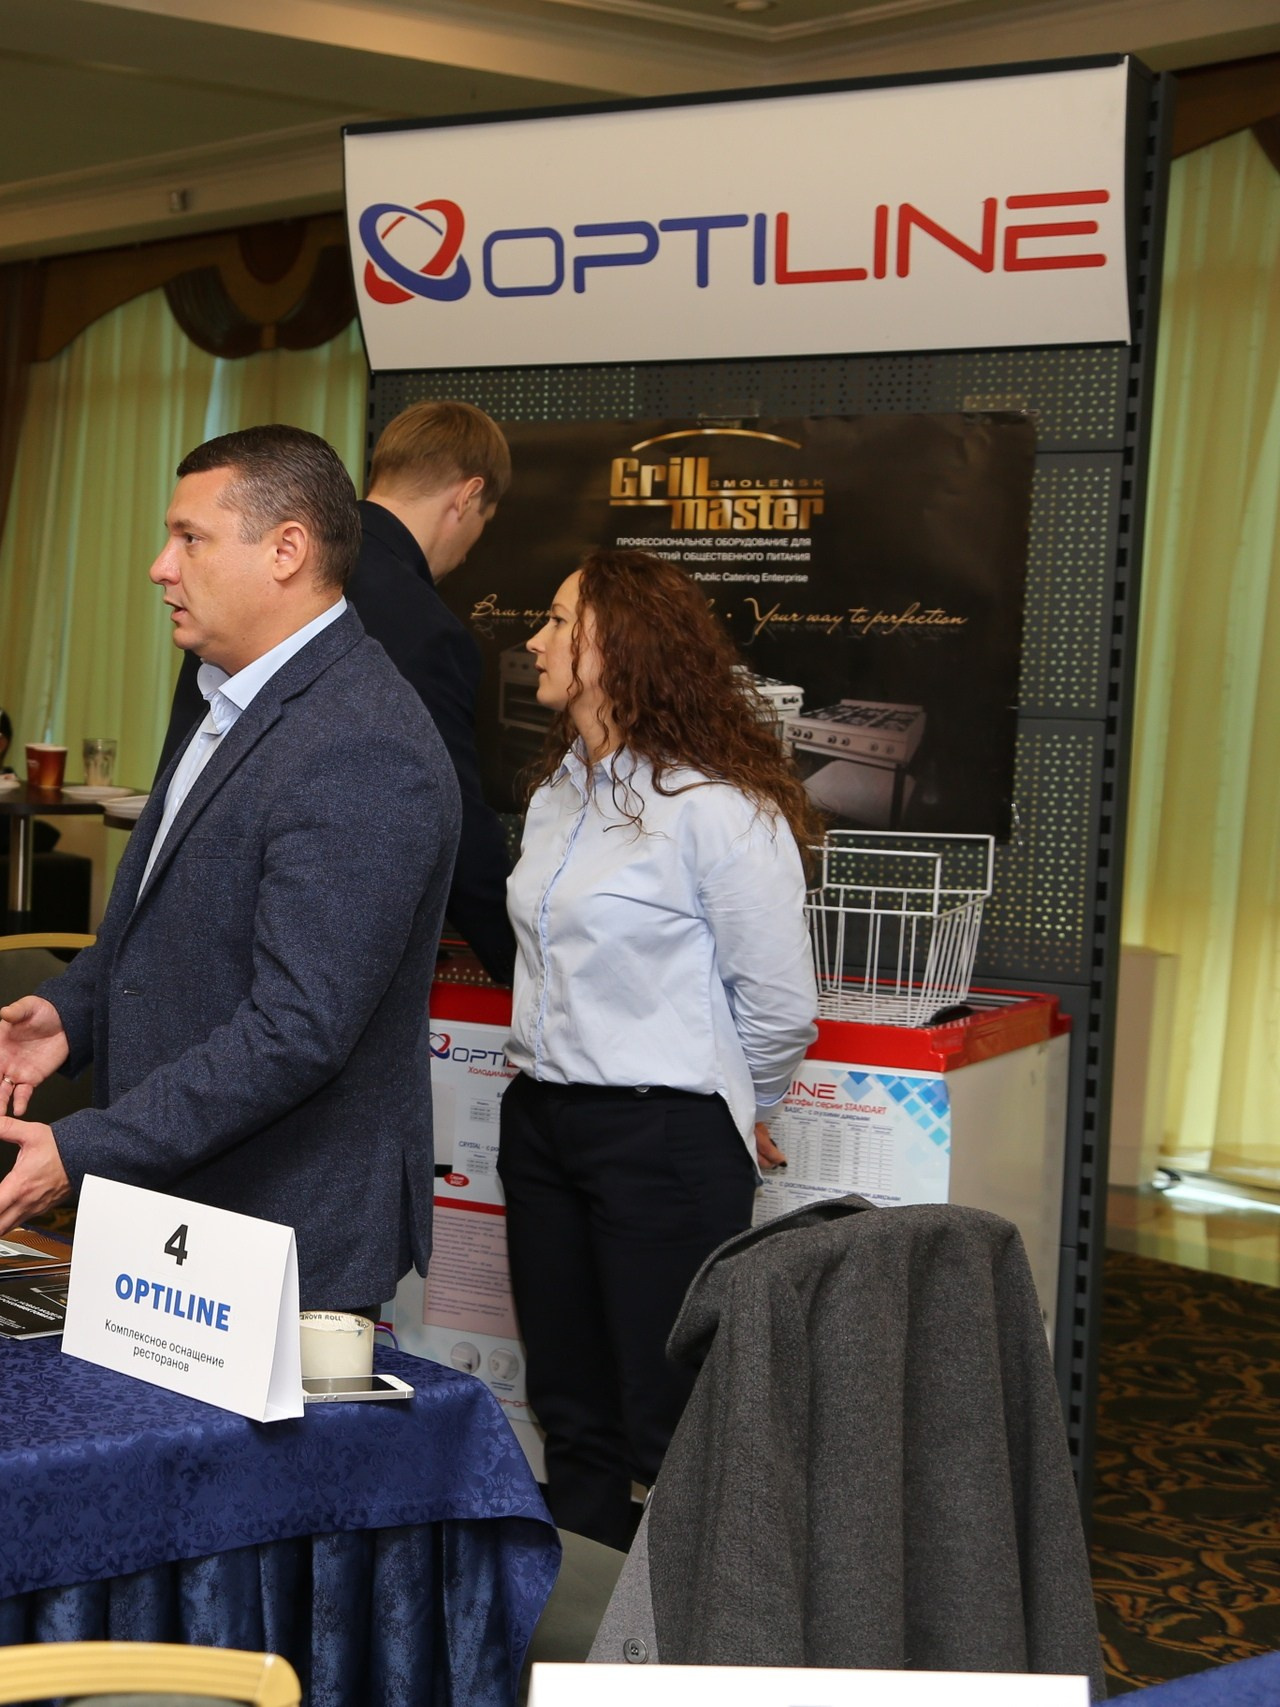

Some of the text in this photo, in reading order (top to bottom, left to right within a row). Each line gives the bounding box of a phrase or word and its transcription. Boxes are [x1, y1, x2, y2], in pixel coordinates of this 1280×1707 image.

[482, 189, 1110, 298] OPTILINE
[610, 457, 710, 497] Grill
[710, 478, 825, 488] SMOLENSK
[671, 495, 825, 531] master
[616, 537, 812, 548] ПРОФЕССИОНАЛЬНОЕ ОБОРУДОВАНИЕ ДЛЯ
[682, 551, 764, 562] ОБЩЕСТВЕННОГО
[766, 551, 811, 562] ПИТАНИЯ
[694, 571, 809, 584] Public Catering Enterprise
[744, 597, 804, 636] Your
[806, 613, 844, 635] way
[848, 606, 868, 624] to
[862, 601, 968, 635] perfection
[468, 1065, 517, 1078] Холодильны
[844, 1103, 888, 1115] STANDART
[164, 1223, 188, 1266] 4
[115, 1273, 231, 1332] OPTILINE
[104, 1319, 225, 1369] Комплексное оснащение
[133, 1346, 190, 1373] ресторанов
